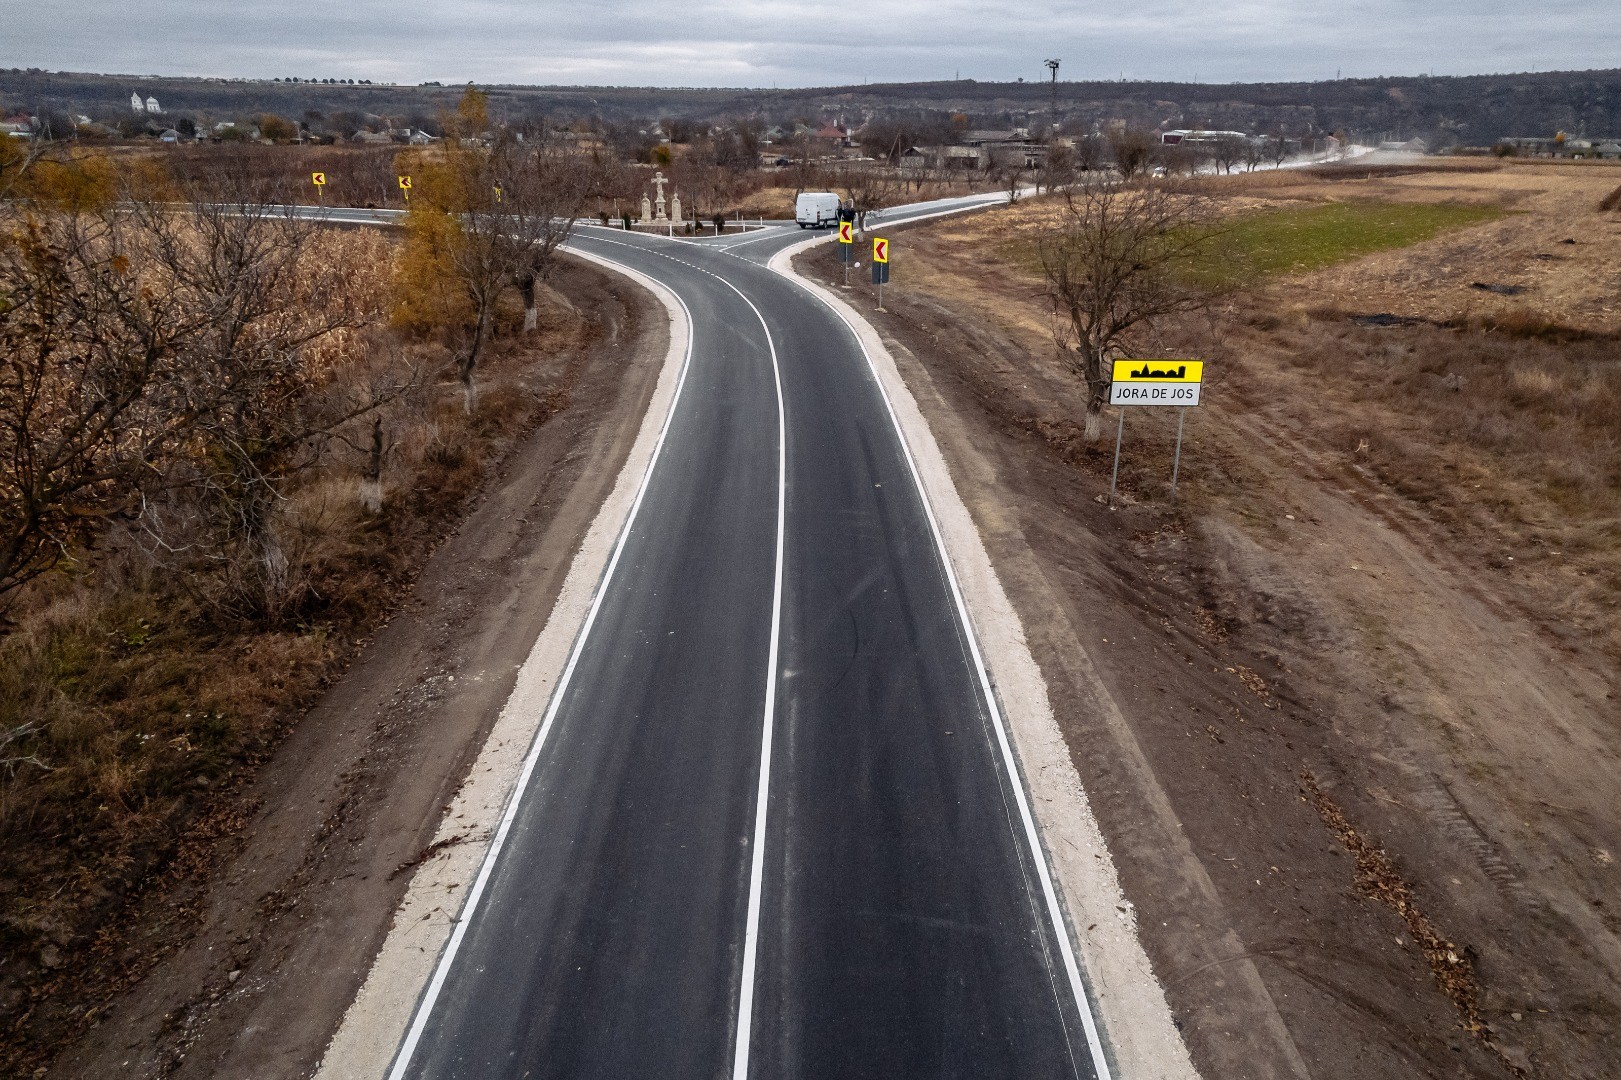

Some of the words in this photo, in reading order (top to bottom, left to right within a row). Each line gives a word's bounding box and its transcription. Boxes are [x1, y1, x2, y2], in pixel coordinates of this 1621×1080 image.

[1116, 388, 1148, 399] JORA
[1152, 388, 1168, 399] DE
[1170, 388, 1194, 399] JOS
